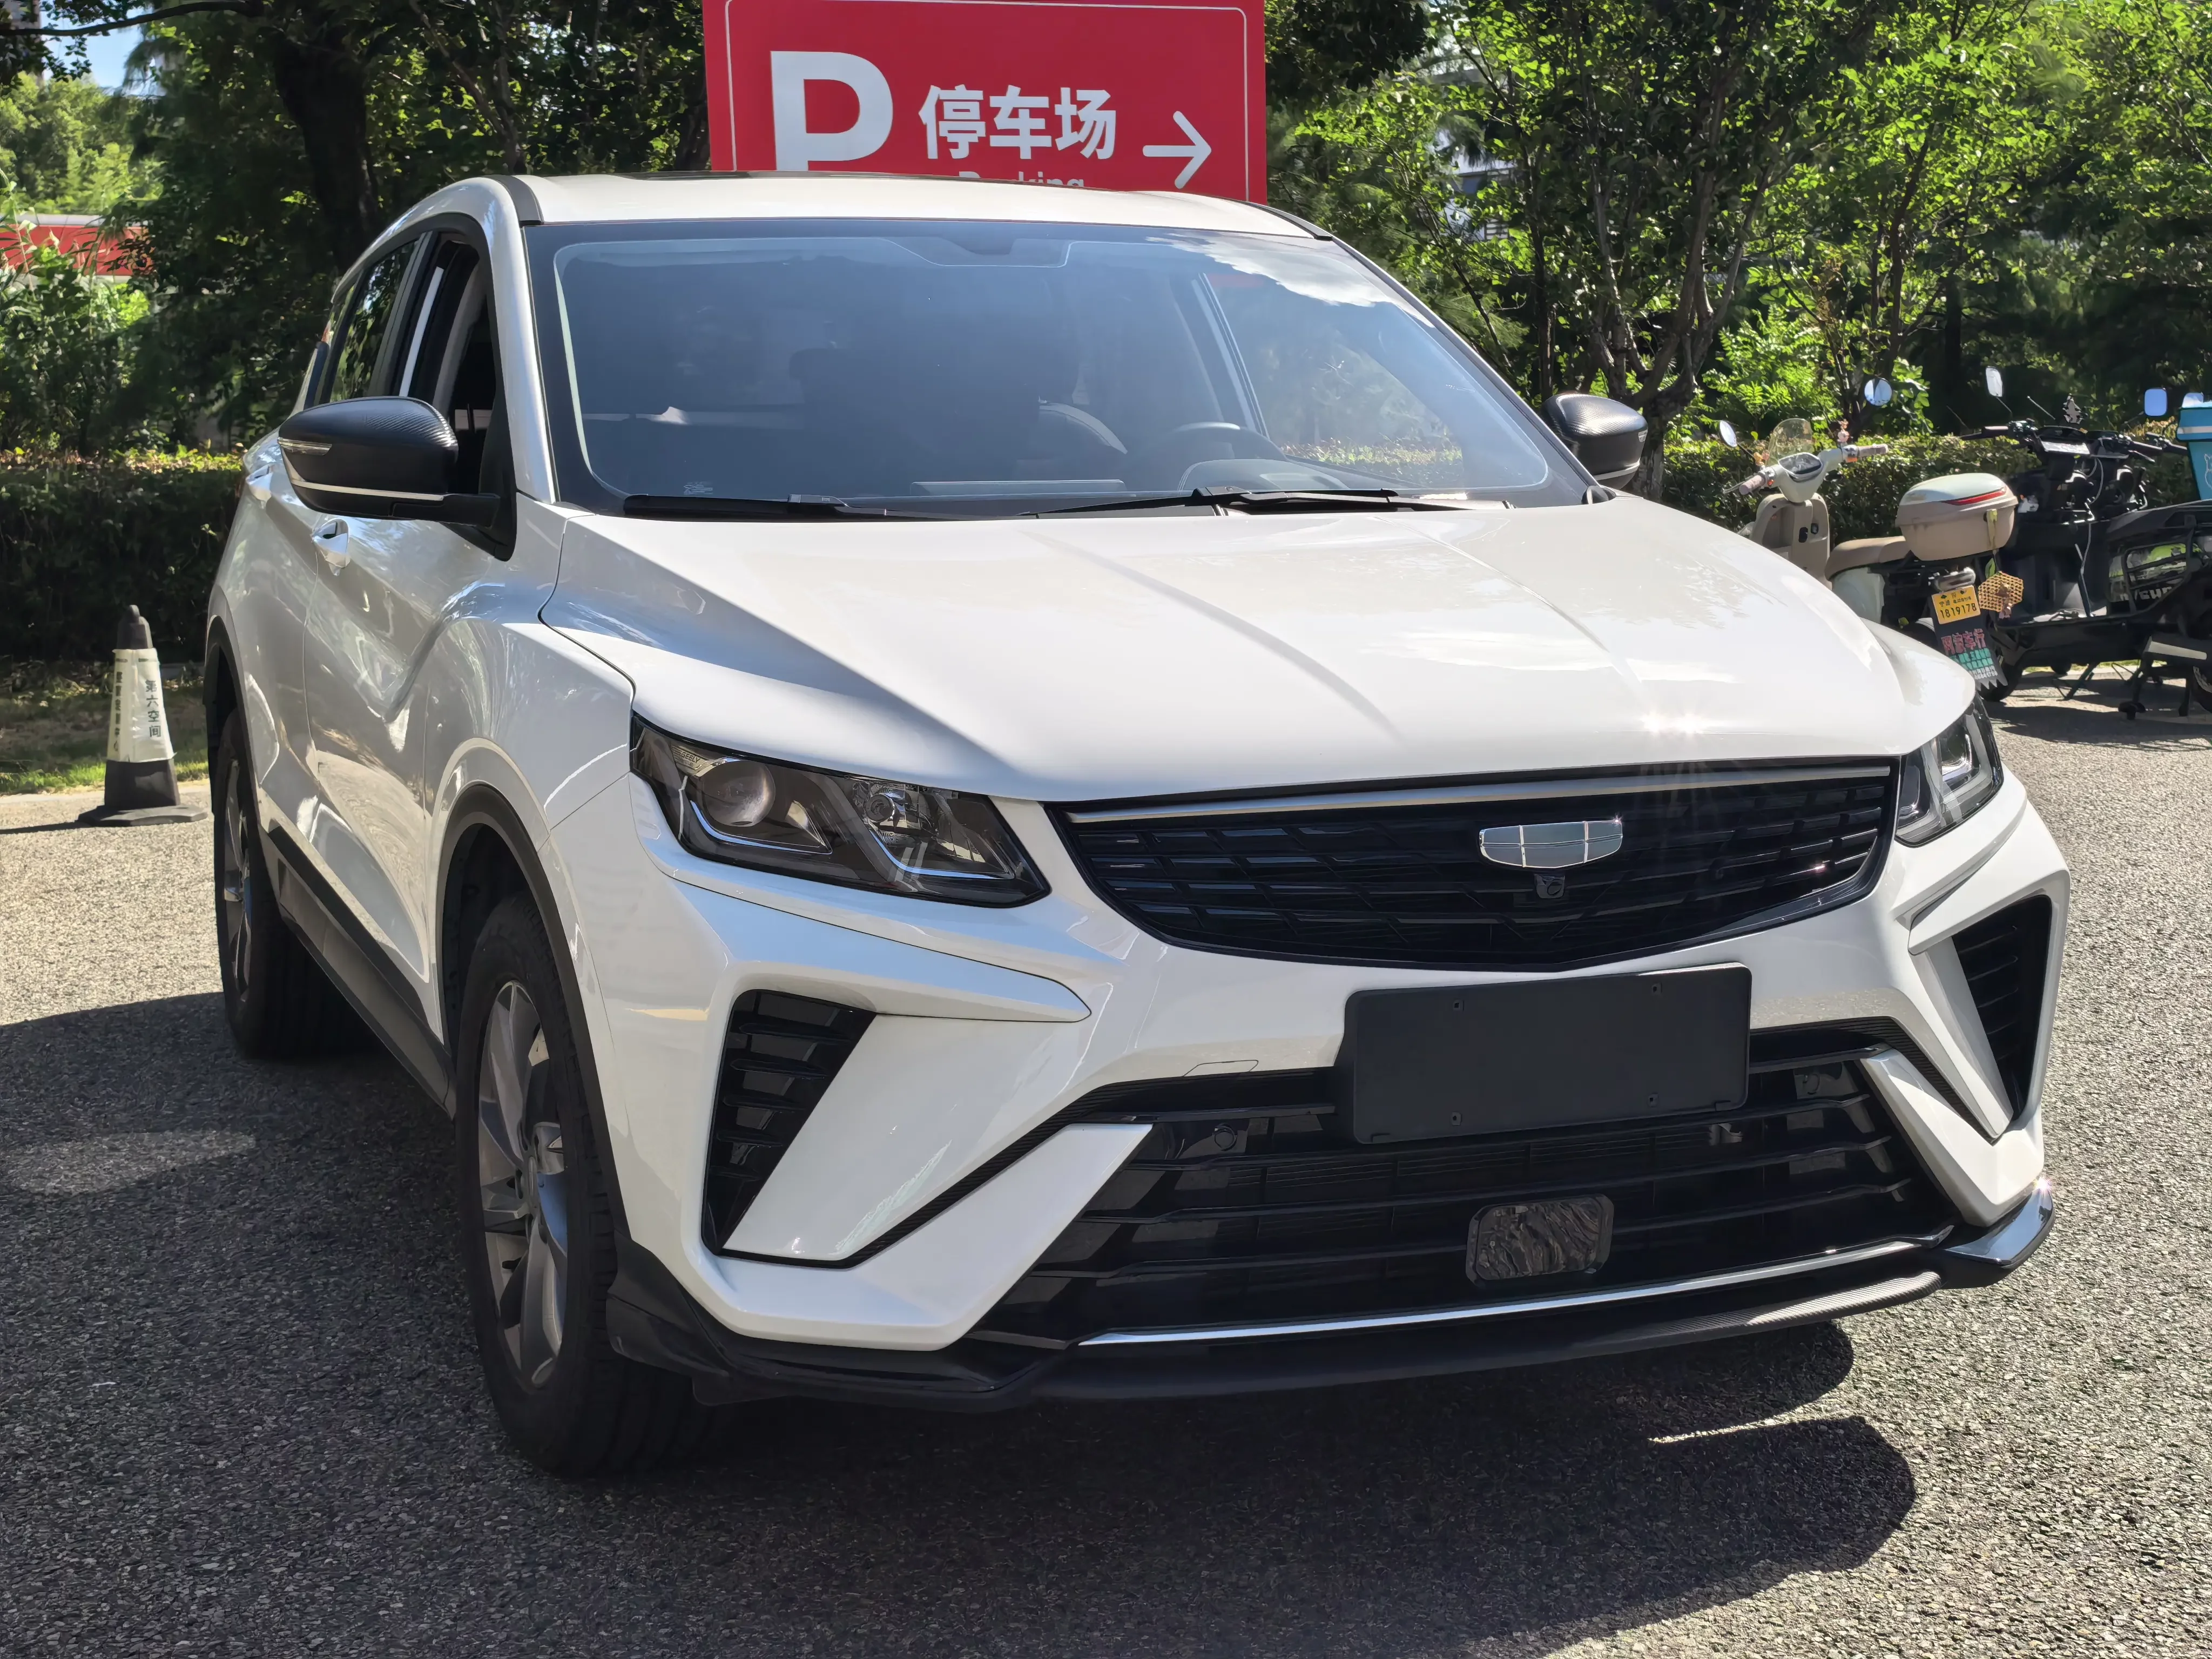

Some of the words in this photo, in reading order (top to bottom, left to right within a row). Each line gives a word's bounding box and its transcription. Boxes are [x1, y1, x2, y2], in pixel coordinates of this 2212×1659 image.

[770, 50, 894, 171] P
[918, 84, 1117, 160] 停车场
[1940, 603, 1977, 619] 1819178
[145, 679, 161, 738] 第六空间
[682, 751, 701, 764] GEELY
